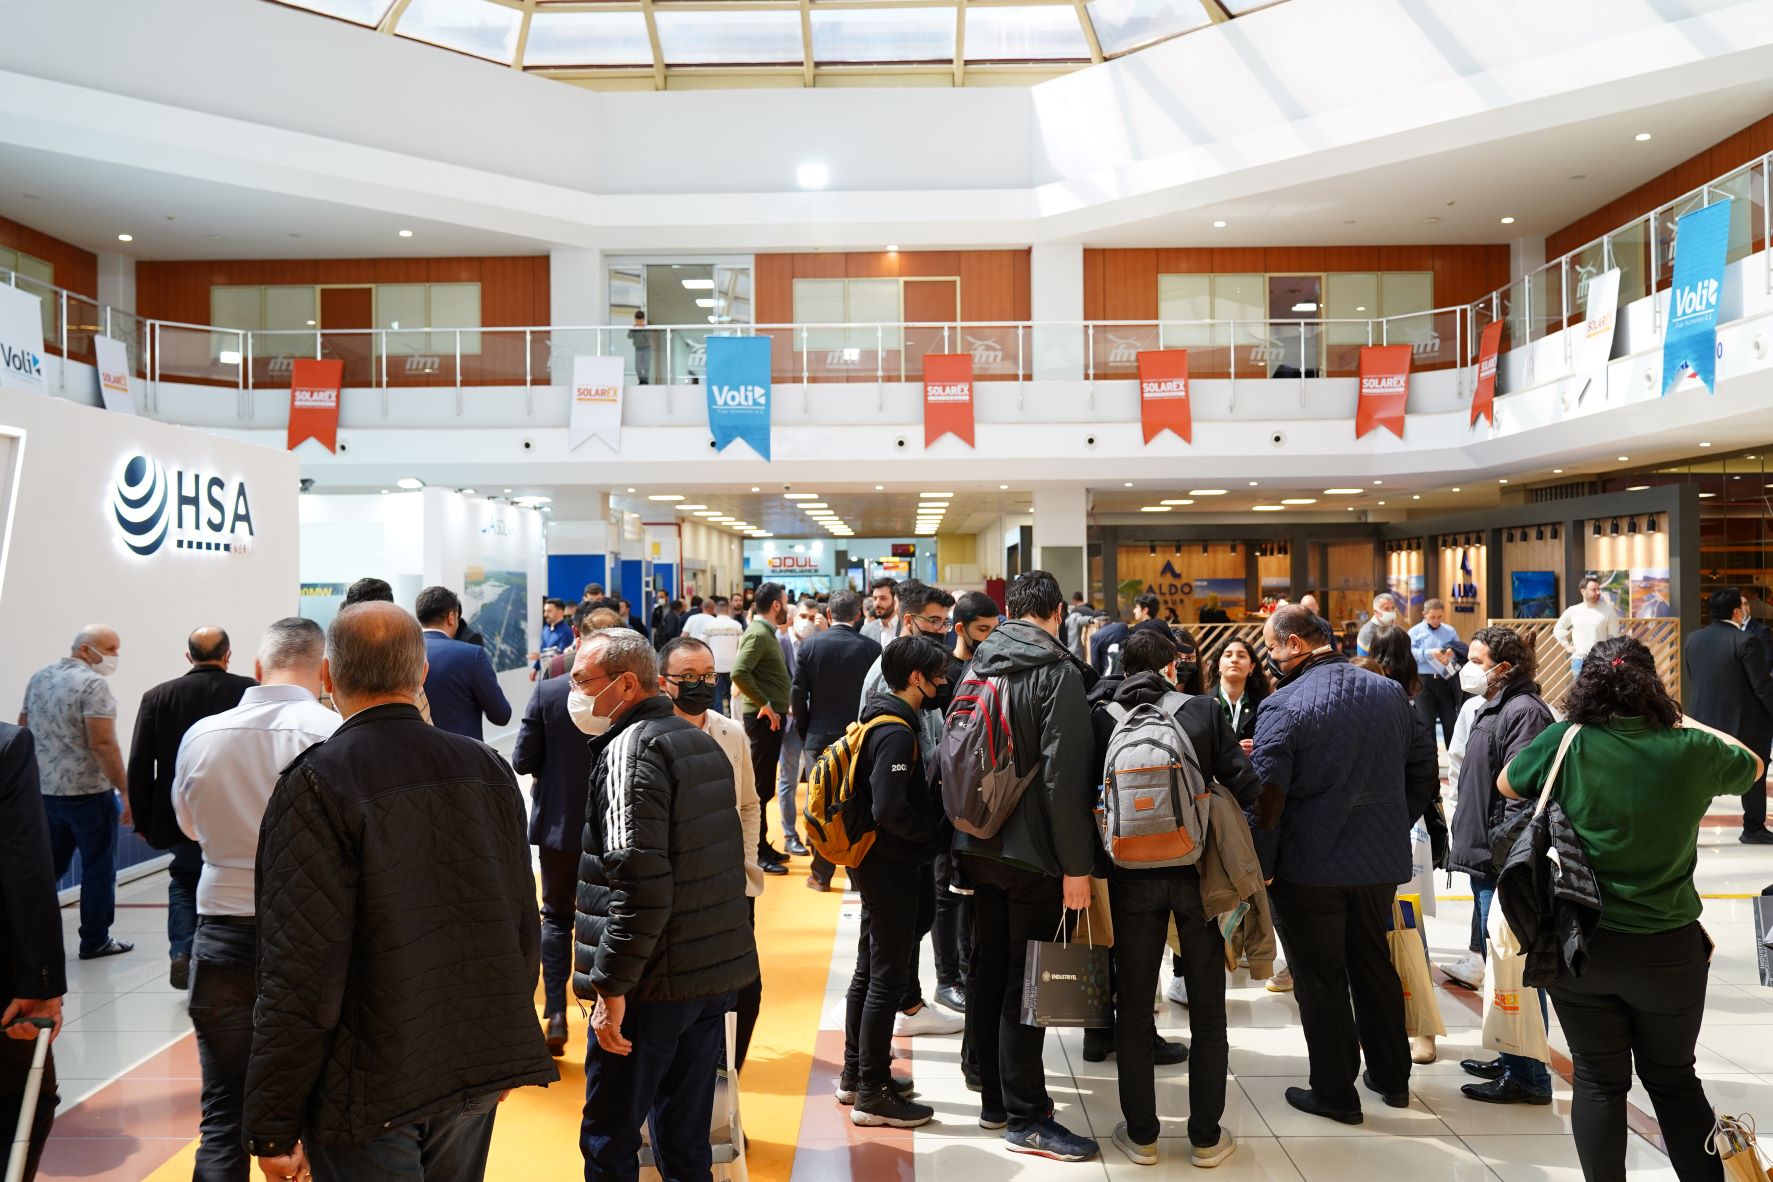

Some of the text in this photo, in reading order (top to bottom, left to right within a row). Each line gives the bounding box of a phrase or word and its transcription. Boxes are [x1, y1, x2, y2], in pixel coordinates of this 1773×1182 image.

[1, 343, 32, 375] Voli
[1143, 380, 1185, 393] SOLAREX
[1362, 376, 1405, 389] SOLAREX
[294, 389, 337, 401] SOLAREX
[577, 387, 619, 397] SOLAREX
[712, 385, 753, 406] Voli
[927, 384, 969, 396] SOLAREX
[177, 471, 254, 536] HSA
[1146, 583, 1193, 596] ALDO
[1023, 978, 1031, 1009] INDUSTRY
